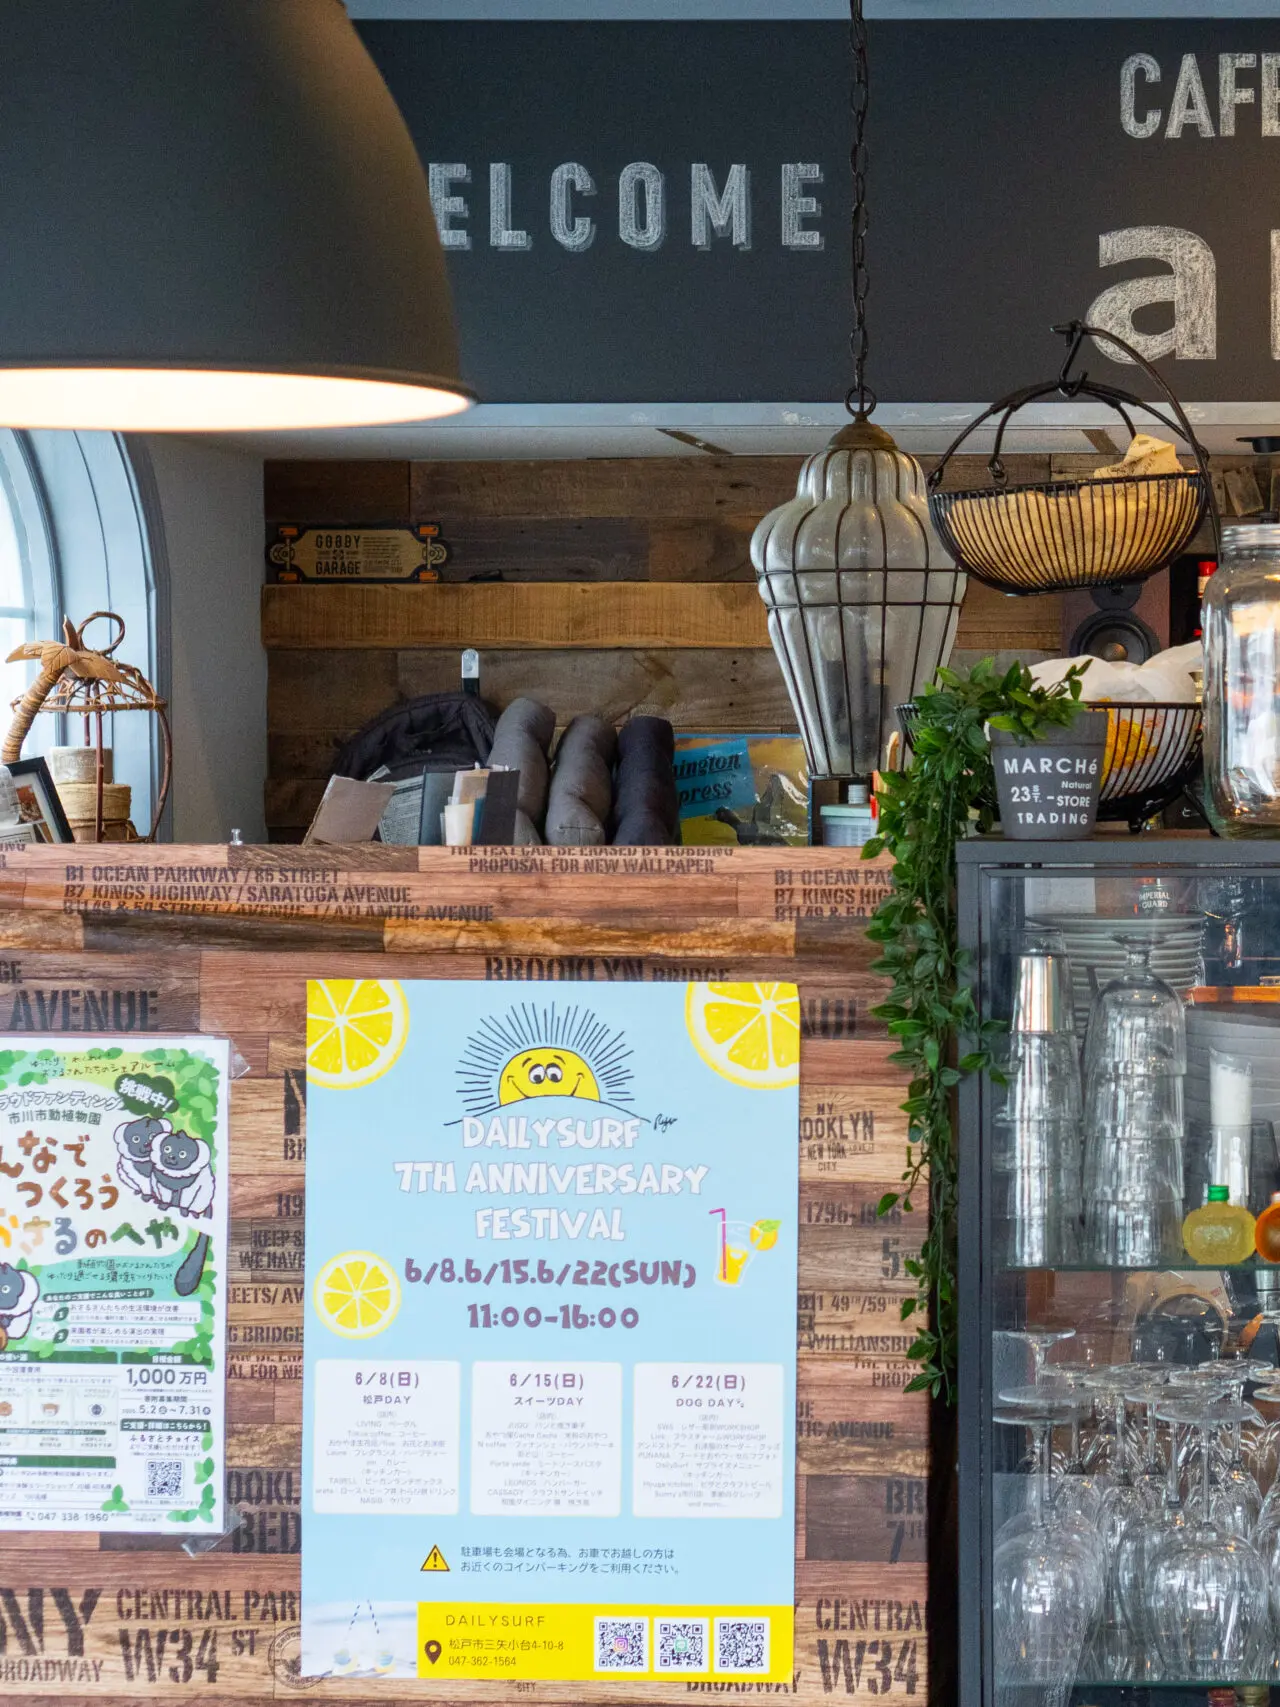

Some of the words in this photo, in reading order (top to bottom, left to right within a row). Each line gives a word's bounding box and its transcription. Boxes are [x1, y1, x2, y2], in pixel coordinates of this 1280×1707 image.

[428, 162, 824, 251] ELCOME
[315, 561, 361, 575] GARAGE
[1003, 757, 1098, 775] MARCHé
[1061, 780, 1093, 790] Natural
[1017, 812, 1089, 825] TRADING
[469, 858, 546, 873] PROPOSAL
[551, 858, 579, 873] FOR
[583, 858, 619, 873] NEW
[623, 858, 715, 873] WALLPAPER
[66, 865, 84, 882] B1
[92, 865, 149, 882] OCEAN
[153, 866, 240, 883] PARKWAY
[278, 868, 341, 884] STREET
[774, 869, 793, 885] B1
[801, 869, 860, 885] OCEAN
[64, 884, 85, 898] B7
[93, 884, 146, 900] KINGS
[150, 885, 232, 901] HIGHWAY
[247, 886, 341, 903] SARATOGA
[343, 886, 412, 903] AVENUE
[774, 888, 795, 904] B7
[802, 888, 855, 904] KINGS
[1142, 900, 1169, 909] GUARD
[425, 906, 494, 921] AVENUE
[484, 956, 643, 981] BROOKLYN
[8, 989, 159, 1032] AVENUE
[8, 1109, 102, 1126] 市川市動植物園
[462, 1115, 642, 1150] DAILYSURF
[799, 1111, 875, 1143] OOKLYN
[807, 1143, 824, 1160] NEW
[827, 1142, 847, 1160] YORK
[818, 1161, 837, 1173] CITY
[393, 1161, 457, 1194] 7TH
[464, 1161, 710, 1196] ANNIVERSARY
[17, 1173, 120, 1211] つくろう
[475, 1207, 626, 1242] FESTIVAL
[467, 1303, 640, 1330] 11:00-16:00
[243, 1326, 304, 1343] BRIDGE
[250, 1364, 278, 1379] FOR
[362, 1395, 412, 1406] 松戸DAY
[513, 1396, 585, 1407] スイーツDAY
[676, 1398, 704, 1408] DOG
[708, 1398, 735, 1408] DAY
[829, 1421, 895, 1438] AVENUE
[129, 1434, 201, 1444] ふるさとチョイス
[460, 1546, 675, 1560] 駐車場も会場となる為、お車でお越しの方は
[460, 1562, 680, 1575] お近くのコインパーキングをご利用ください。
[116, 1587, 238, 1622] CENTRAL
[243, 1589, 302, 1622] PAR
[445, 1614, 546, 1628] DAILYSURF
[816, 1599, 928, 1631] CENTRA
[449, 1638, 565, 1652] 松戸市三矢小台4-10-8
[119, 1628, 220, 1684] W34
[231, 1629, 260, 1657] ST
[448, 1655, 518, 1667] 047-362-1564
[816, 1639, 919, 1695] W34
